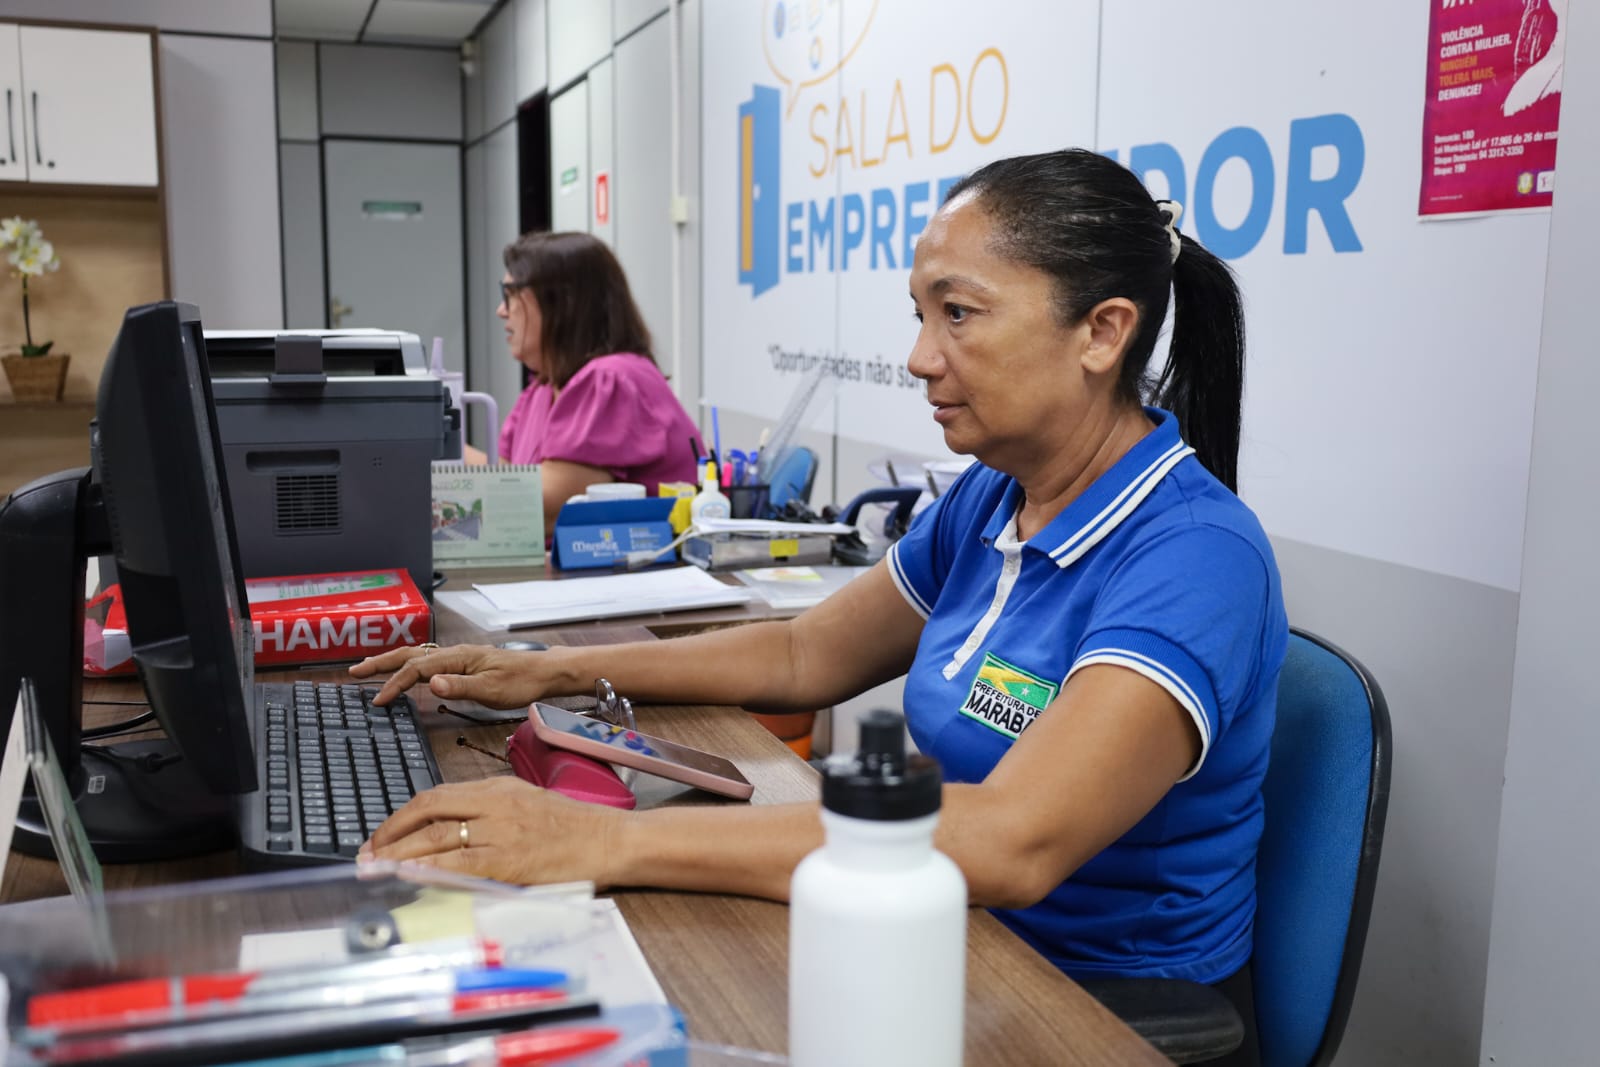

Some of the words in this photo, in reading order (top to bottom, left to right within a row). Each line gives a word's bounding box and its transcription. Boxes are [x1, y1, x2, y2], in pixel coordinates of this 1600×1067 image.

[1441, 24, 1483, 44] VIOLÊNCIA
[1441, 41, 1473, 58] CONTRA
[1475, 33, 1512, 51] MULHER.
[1439, 71, 1470, 87] TOLERA
[1438, 83, 1482, 101] DENUNCIE!
[809, 79, 913, 179] SALA
[930, 47, 1009, 154] DO
[865, 353, 892, 386] não
[974, 681, 1025, 713] PREFEITURA
[1026, 706, 1041, 718] DE
